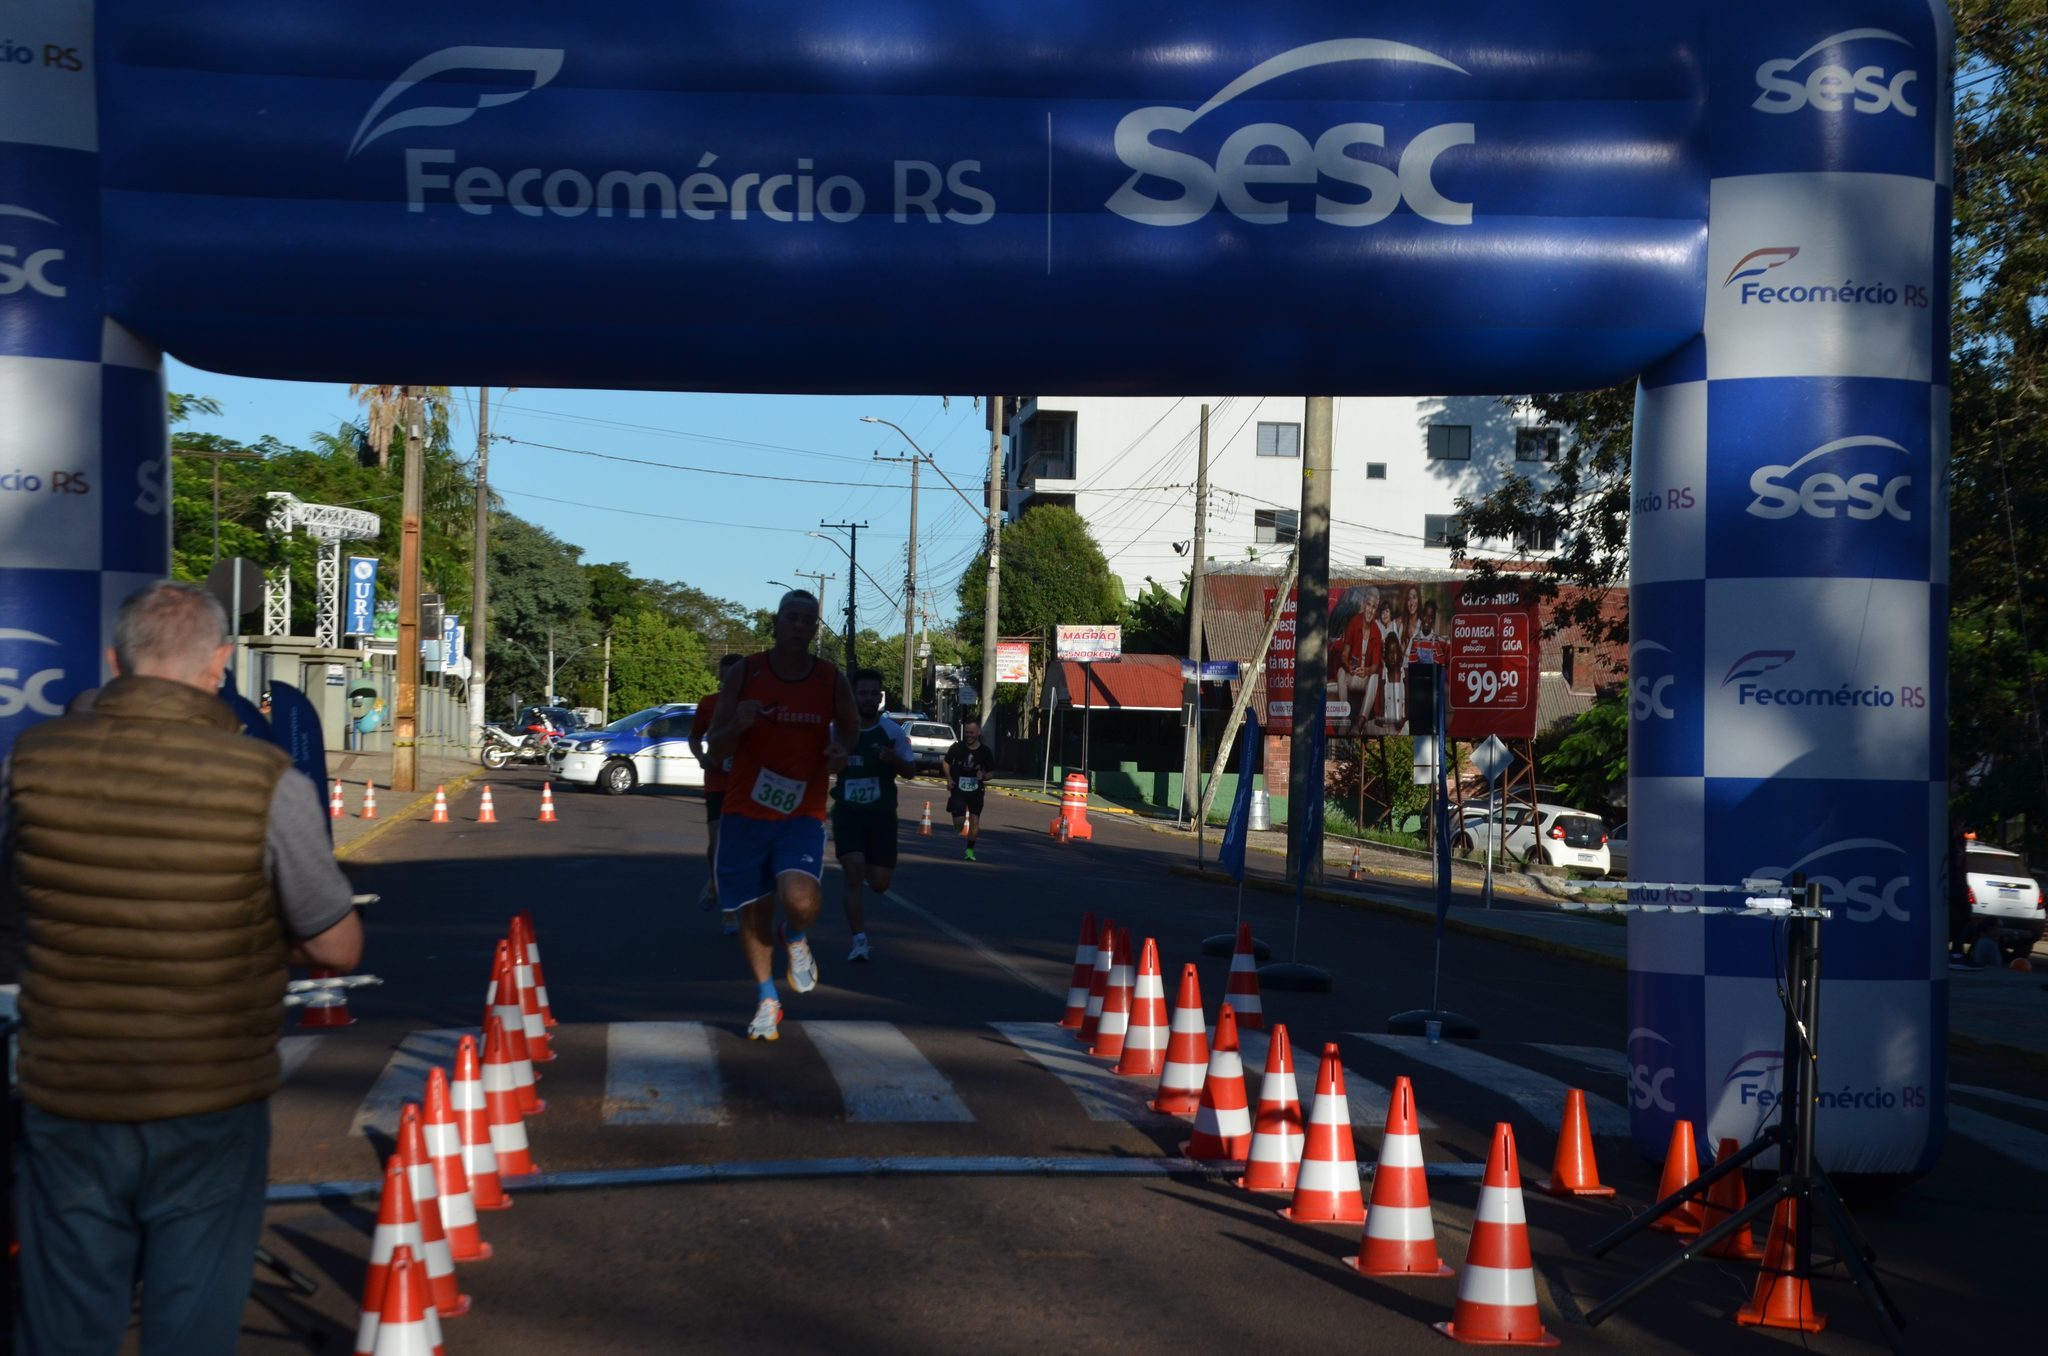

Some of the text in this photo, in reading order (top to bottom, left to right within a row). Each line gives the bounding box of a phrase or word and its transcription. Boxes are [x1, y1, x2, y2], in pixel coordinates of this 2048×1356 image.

[44, 44, 83, 72] RS
[1752, 58, 1918, 117] Sesc
[1104, 106, 1476, 227] Sesc
[405, 148, 996, 225] Fecomércio RS
[1741, 280, 1929, 309] Fecomércio RS
[51, 471, 90, 495] RS
[1745, 464, 1911, 521] Sesc
[1667, 486, 1696, 510] RS
[353, 582, 370, 632] URI
[1455, 626, 1495, 638] 600 MEGA
[1502, 640, 1523, 651] GIGA
[1503, 626, 1514, 638] 60
[1278, 657, 1289, 669] na
[0, 667, 65, 716] sc
[1739, 683, 1926, 709] Fecomércio RS
[758, 783, 796, 811] 368
[849, 787, 875, 801] 427
[1741, 1084, 1926, 1109] Femércio RS
